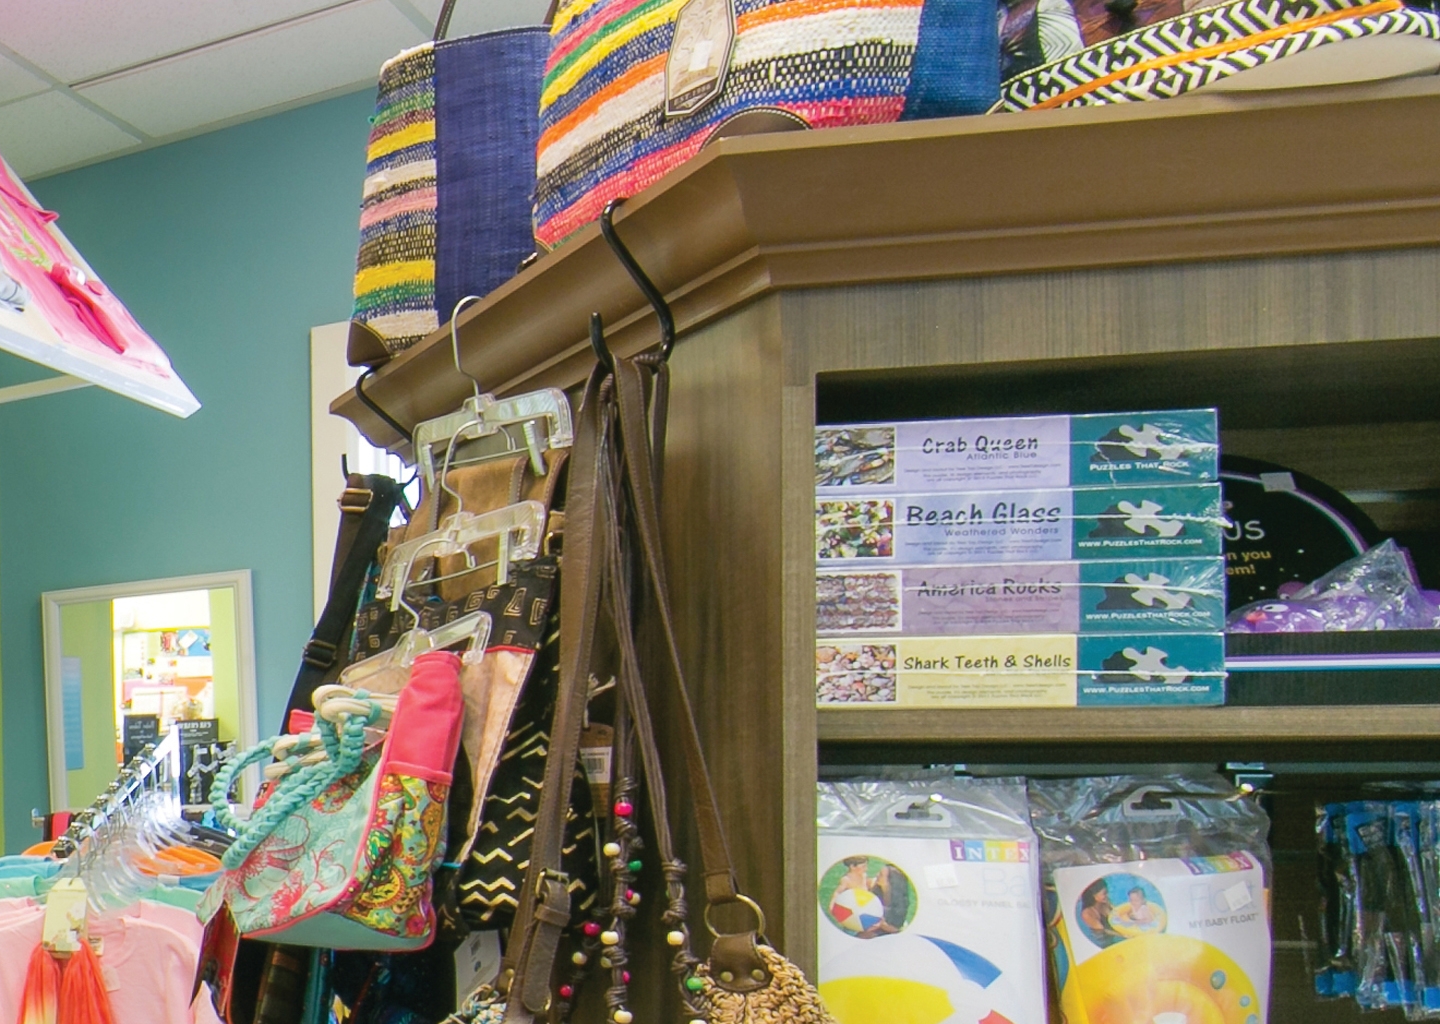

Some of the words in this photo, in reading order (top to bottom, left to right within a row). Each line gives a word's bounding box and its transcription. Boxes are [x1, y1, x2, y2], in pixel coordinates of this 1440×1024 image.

[923, 437, 967, 454] Crab
[975, 435, 1039, 453] Queen
[967, 452, 1011, 460] Atlantic
[1014, 451, 1037, 459] Blue
[906, 503, 983, 526] Beach
[992, 502, 1061, 524] Glass
[944, 528, 1006, 536] Weathered
[1010, 527, 1059, 535] Wonders
[918, 580, 997, 597] America
[1002, 577, 1062, 595] Rocks
[903, 656, 950, 671] Shark
[954, 655, 1000, 669] Teeth
[1004, 655, 1018, 669] &
[1023, 654, 1072, 669] Shells
[1205, 917, 1228, 928] BABY
[1230, 914, 1257, 924] FLOAT
